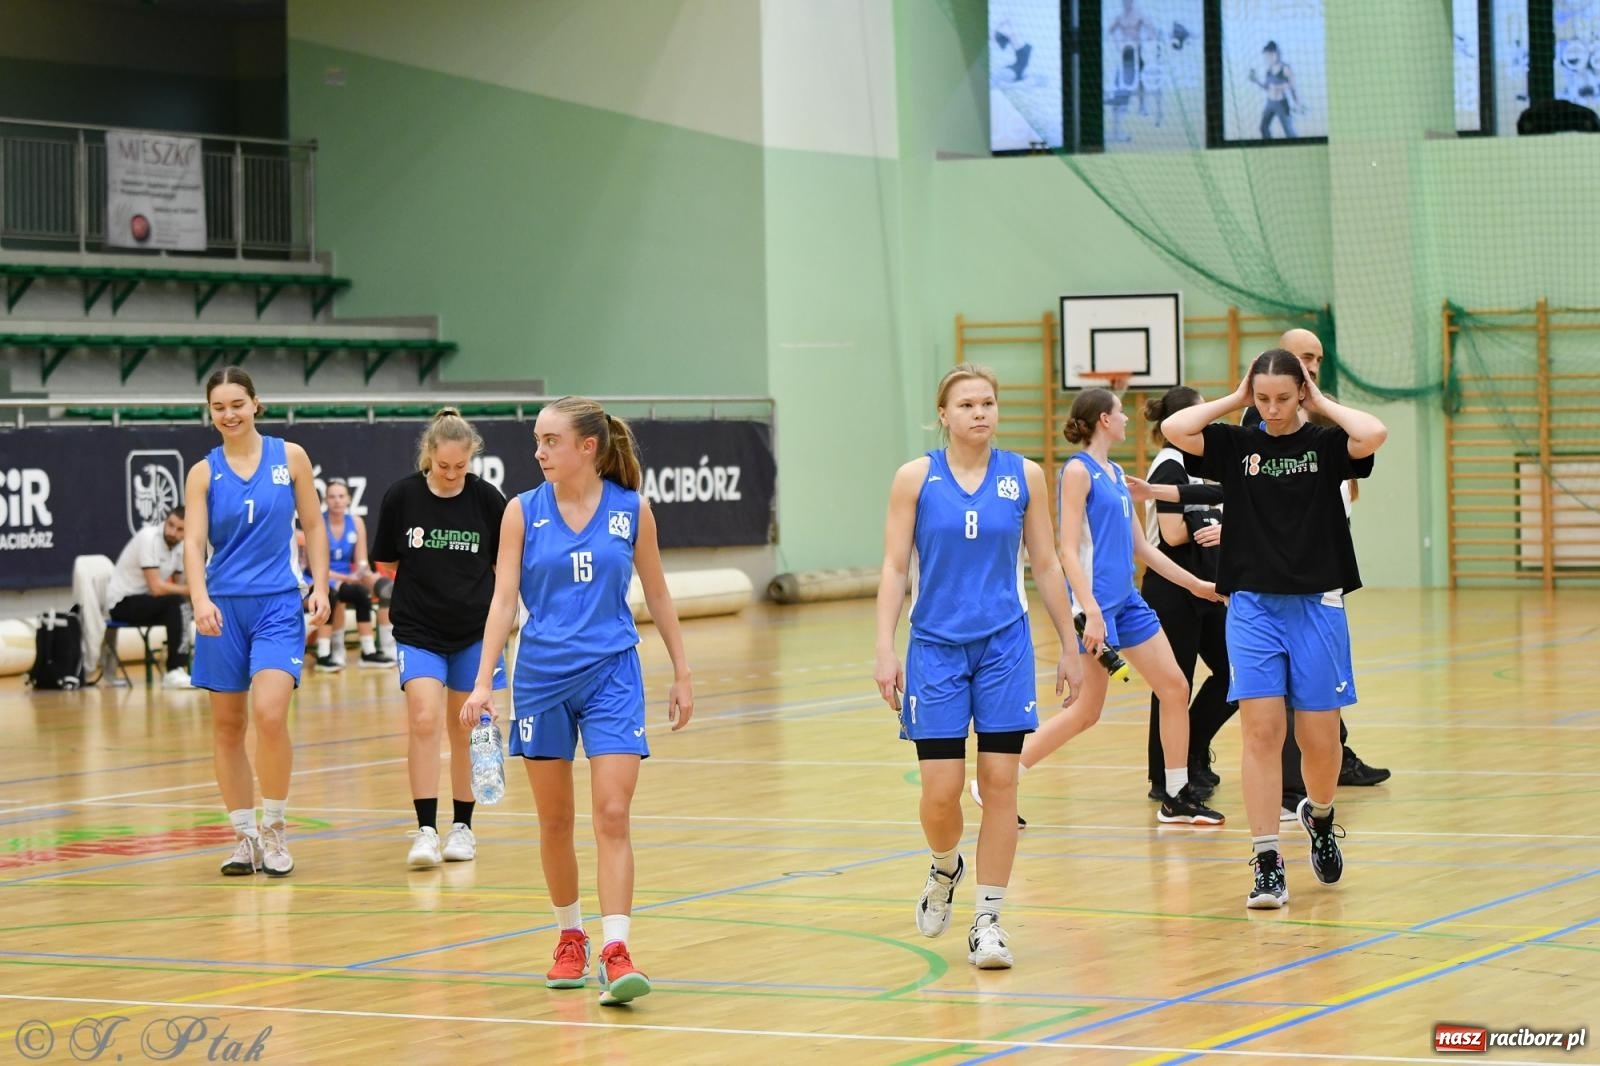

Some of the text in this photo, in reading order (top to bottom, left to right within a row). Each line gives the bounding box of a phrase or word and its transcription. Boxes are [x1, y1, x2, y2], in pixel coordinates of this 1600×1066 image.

[640, 454, 742, 503] ACIBÓRZ
[1285, 466, 1308, 475] 2023
[405, 526, 425, 549] 18
[965, 510, 978, 540] 8
[570, 551, 593, 583] 15
[519, 716, 534, 743] 15
